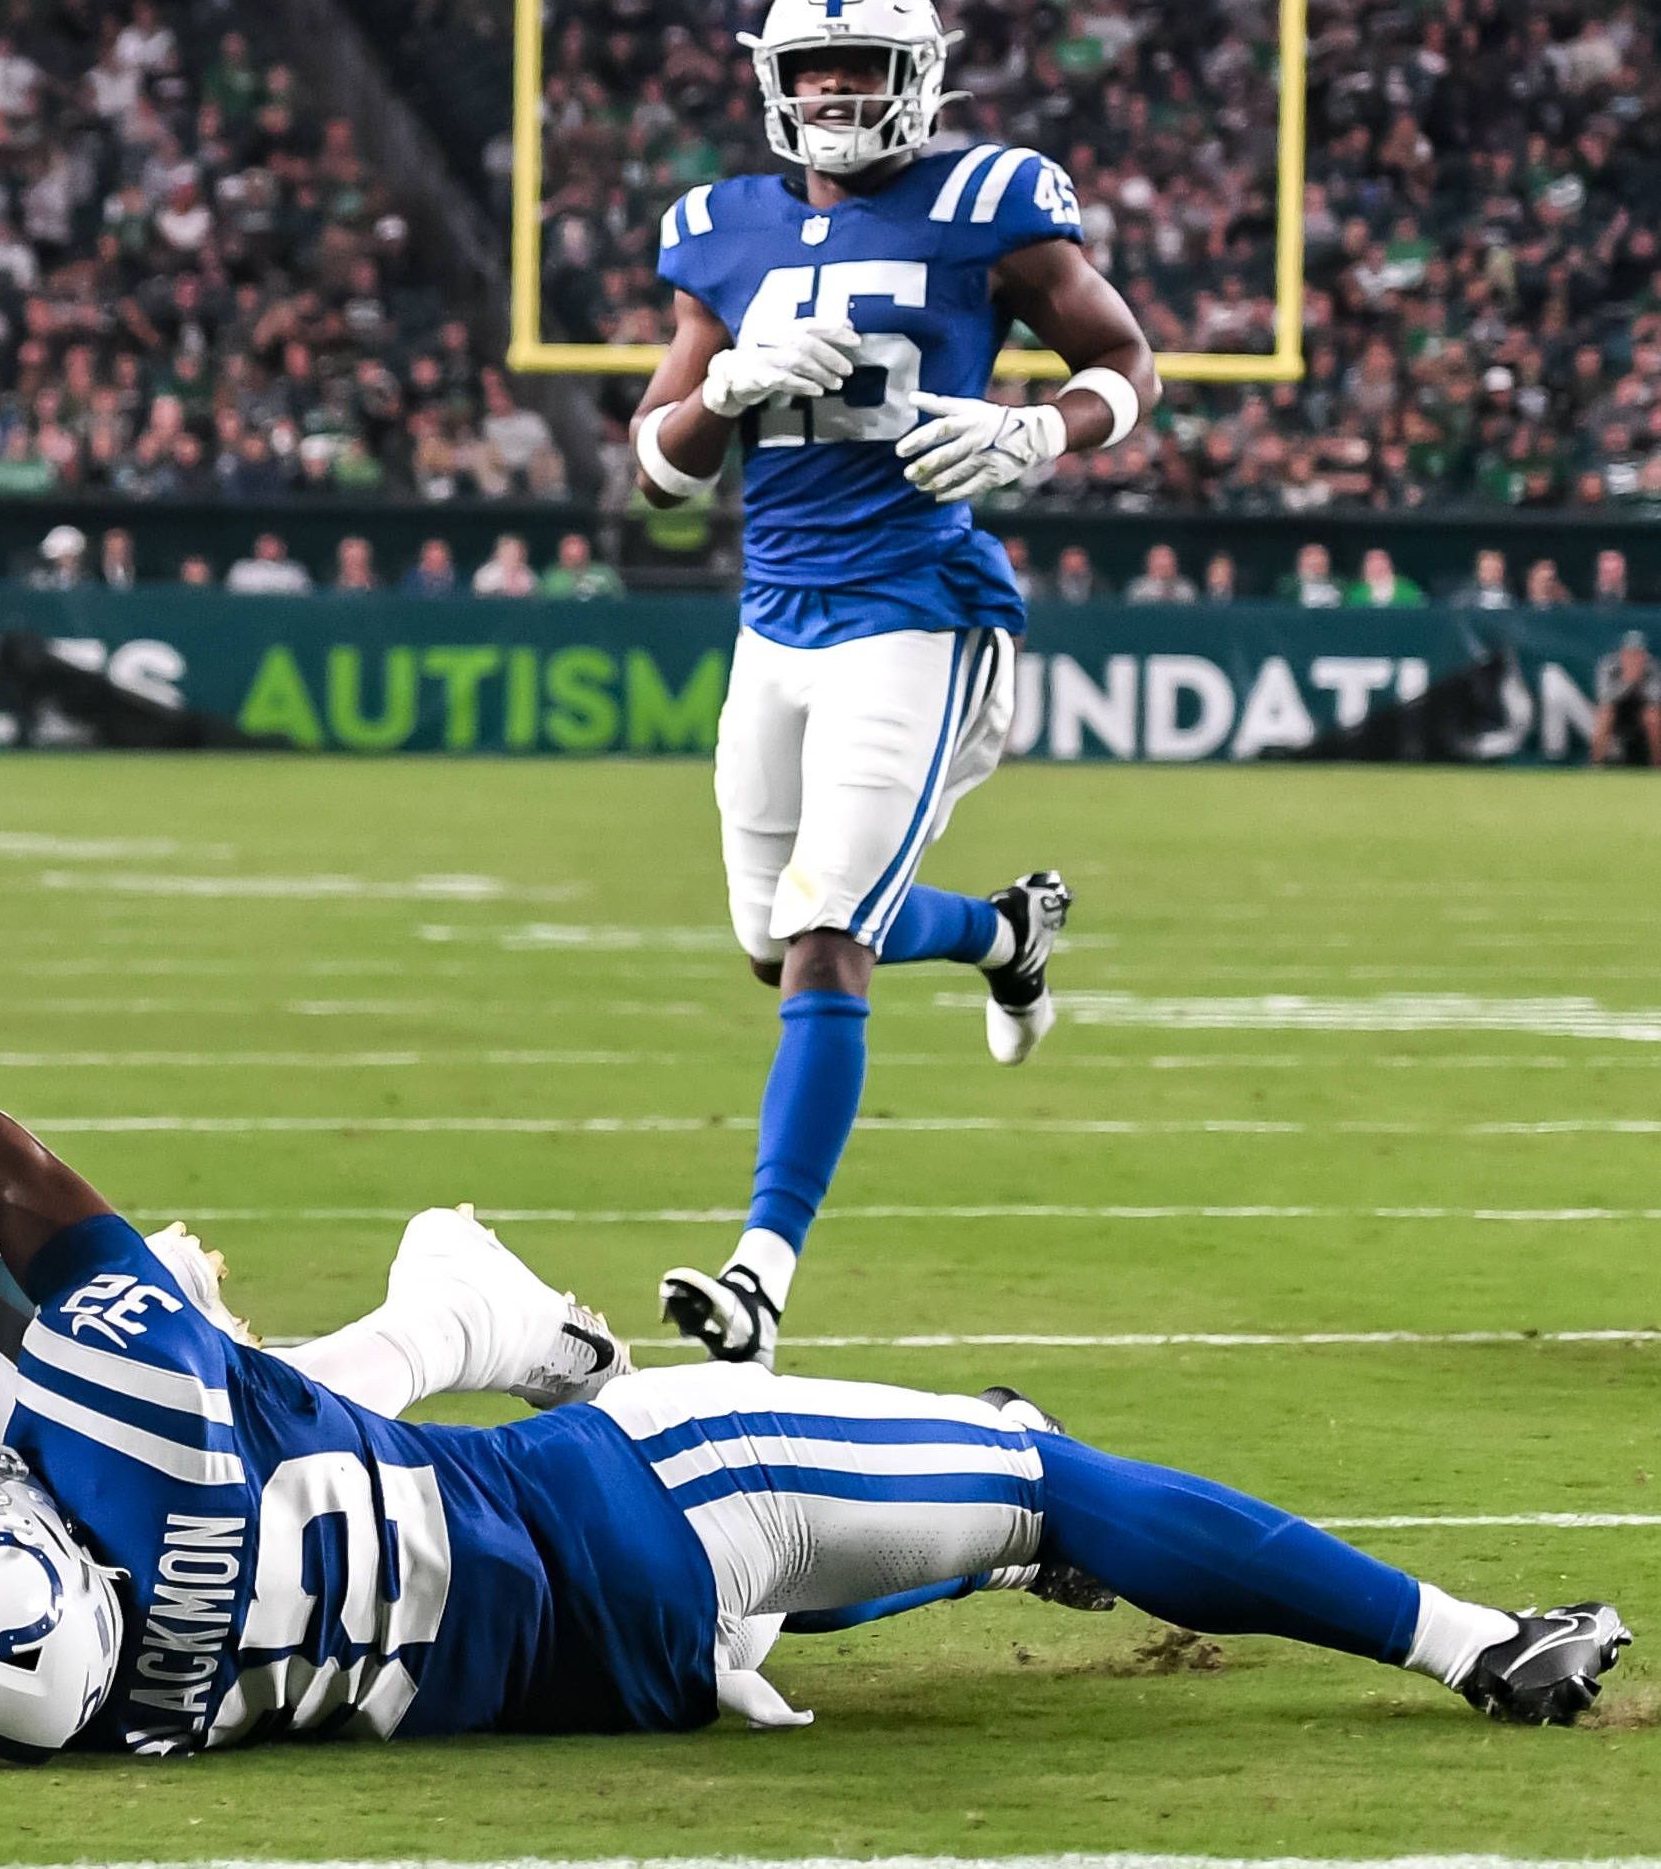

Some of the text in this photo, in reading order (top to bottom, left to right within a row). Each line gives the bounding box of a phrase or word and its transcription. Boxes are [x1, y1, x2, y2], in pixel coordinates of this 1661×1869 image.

[1033, 166, 1081, 225] 45
[736, 259, 928, 448] 45
[237, 643, 728, 750] AUTISM
[59, 1273, 184, 1335] 32
